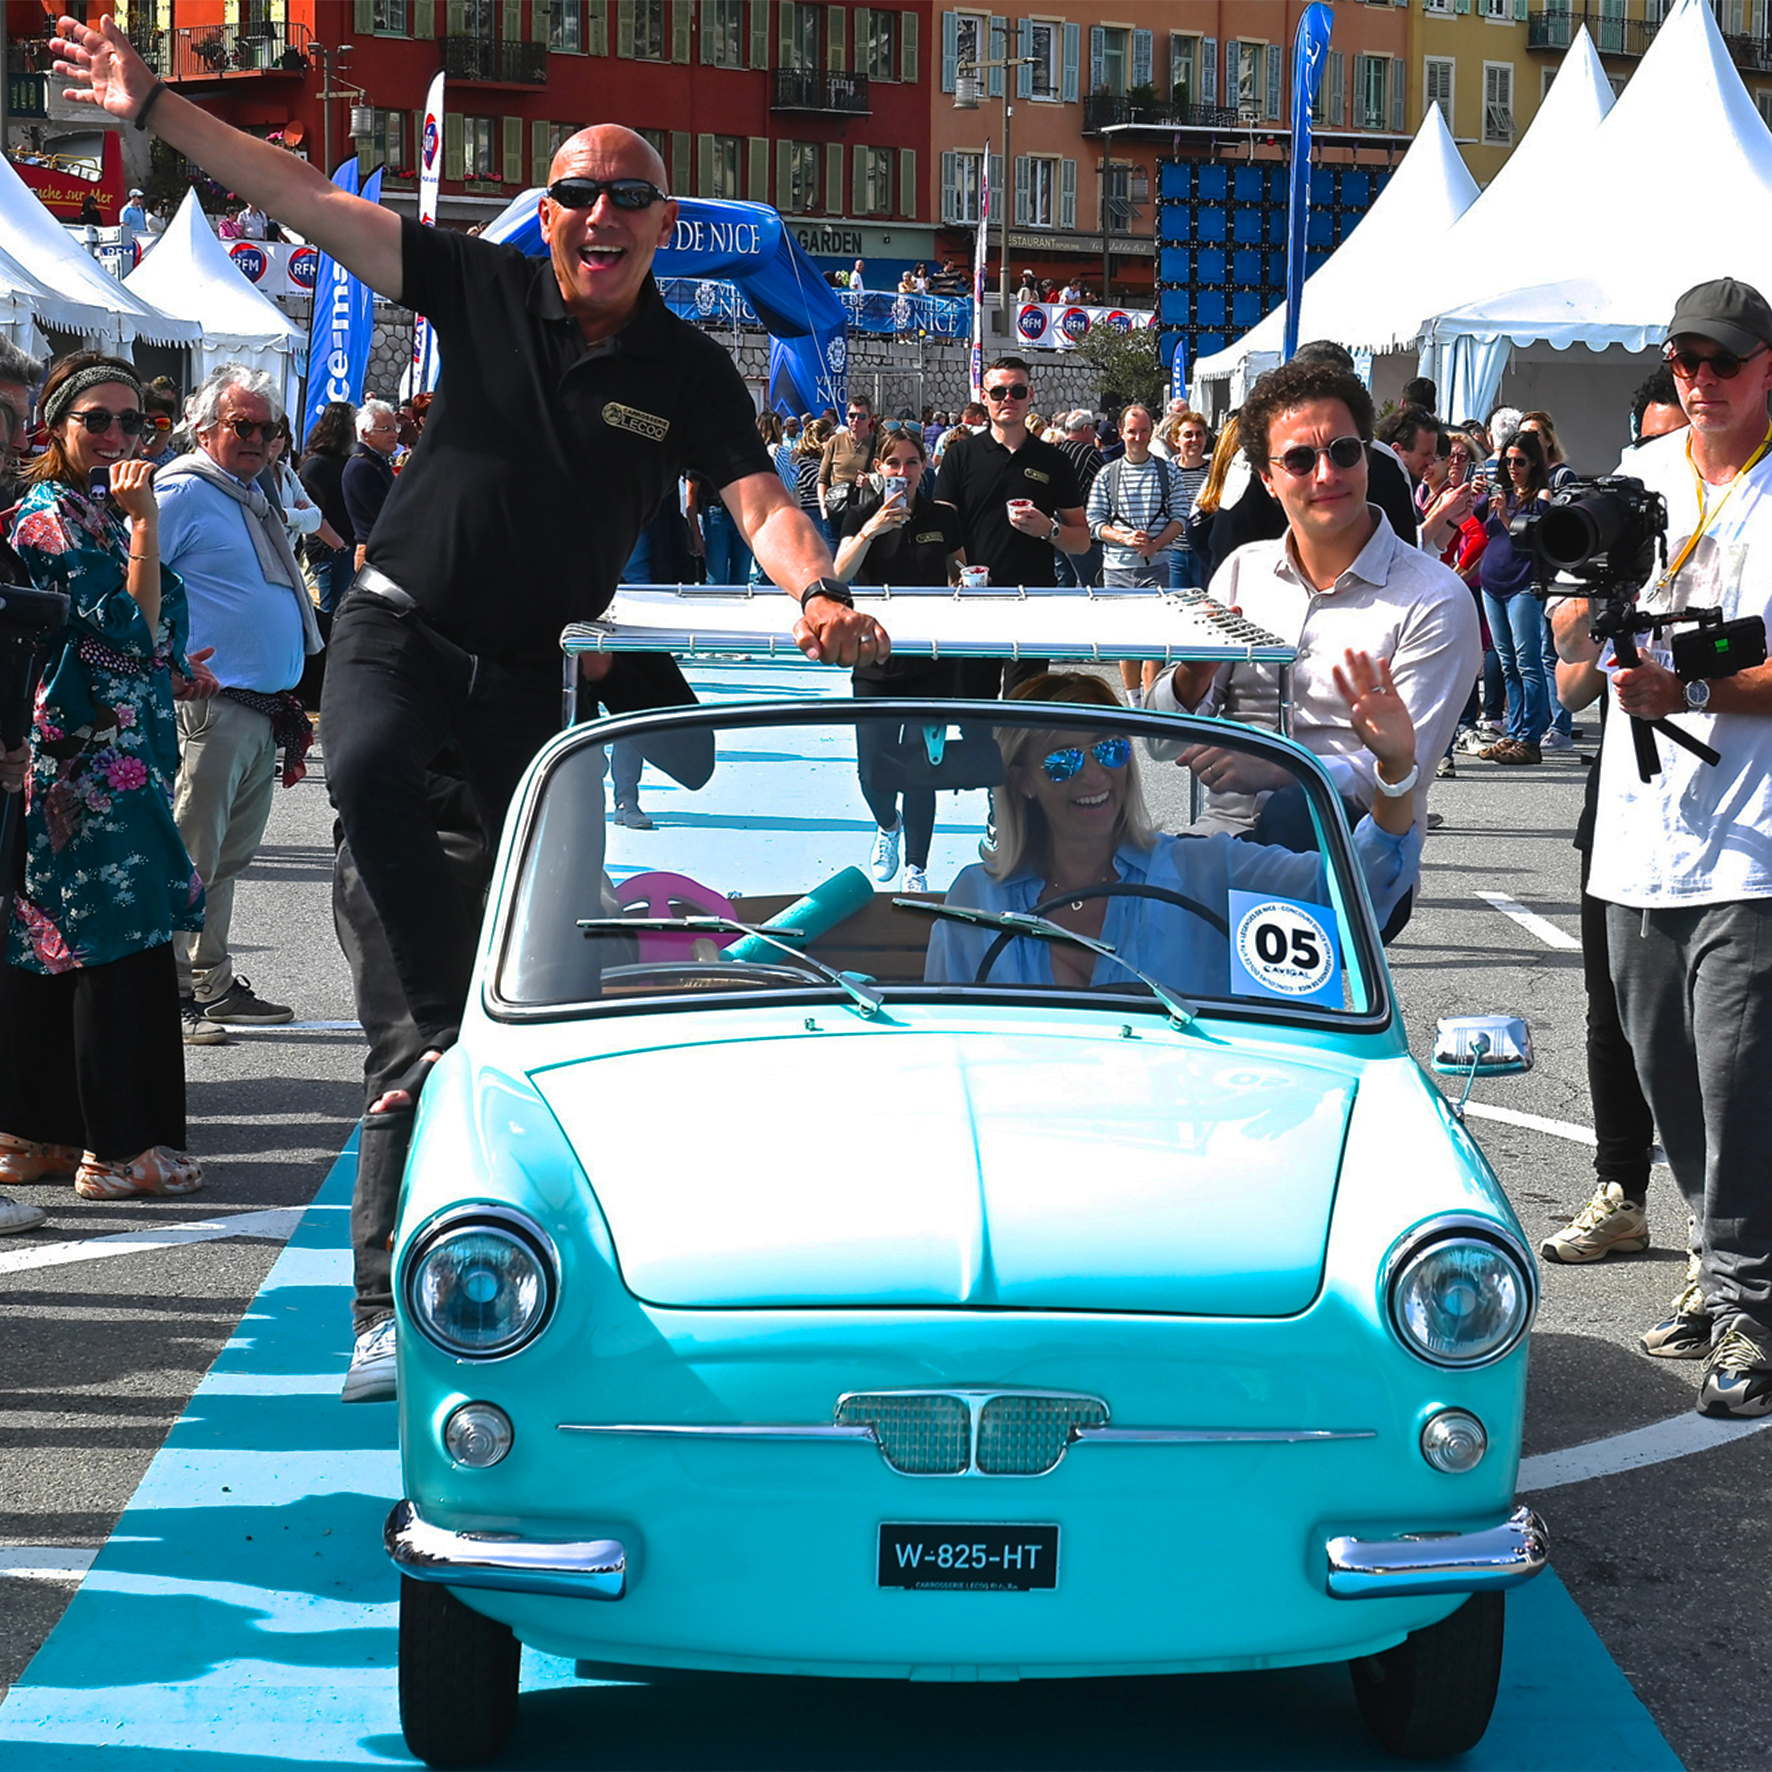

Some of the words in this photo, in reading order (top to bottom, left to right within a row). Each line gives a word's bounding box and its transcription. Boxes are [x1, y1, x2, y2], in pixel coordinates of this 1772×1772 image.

[89, 188, 114, 204] Mer
[676, 219, 704, 252] DE
[708, 222, 761, 255] NICE
[798, 229, 863, 254] GARDEN
[912, 311, 959, 333] NICE
[1022, 317, 1042, 330] RFM
[1065, 320, 1085, 332] RFM
[1255, 923, 1320, 970] 05
[1263, 964, 1312, 980] CAVIGAL
[895, 1543, 1043, 1570] W-825-HT
